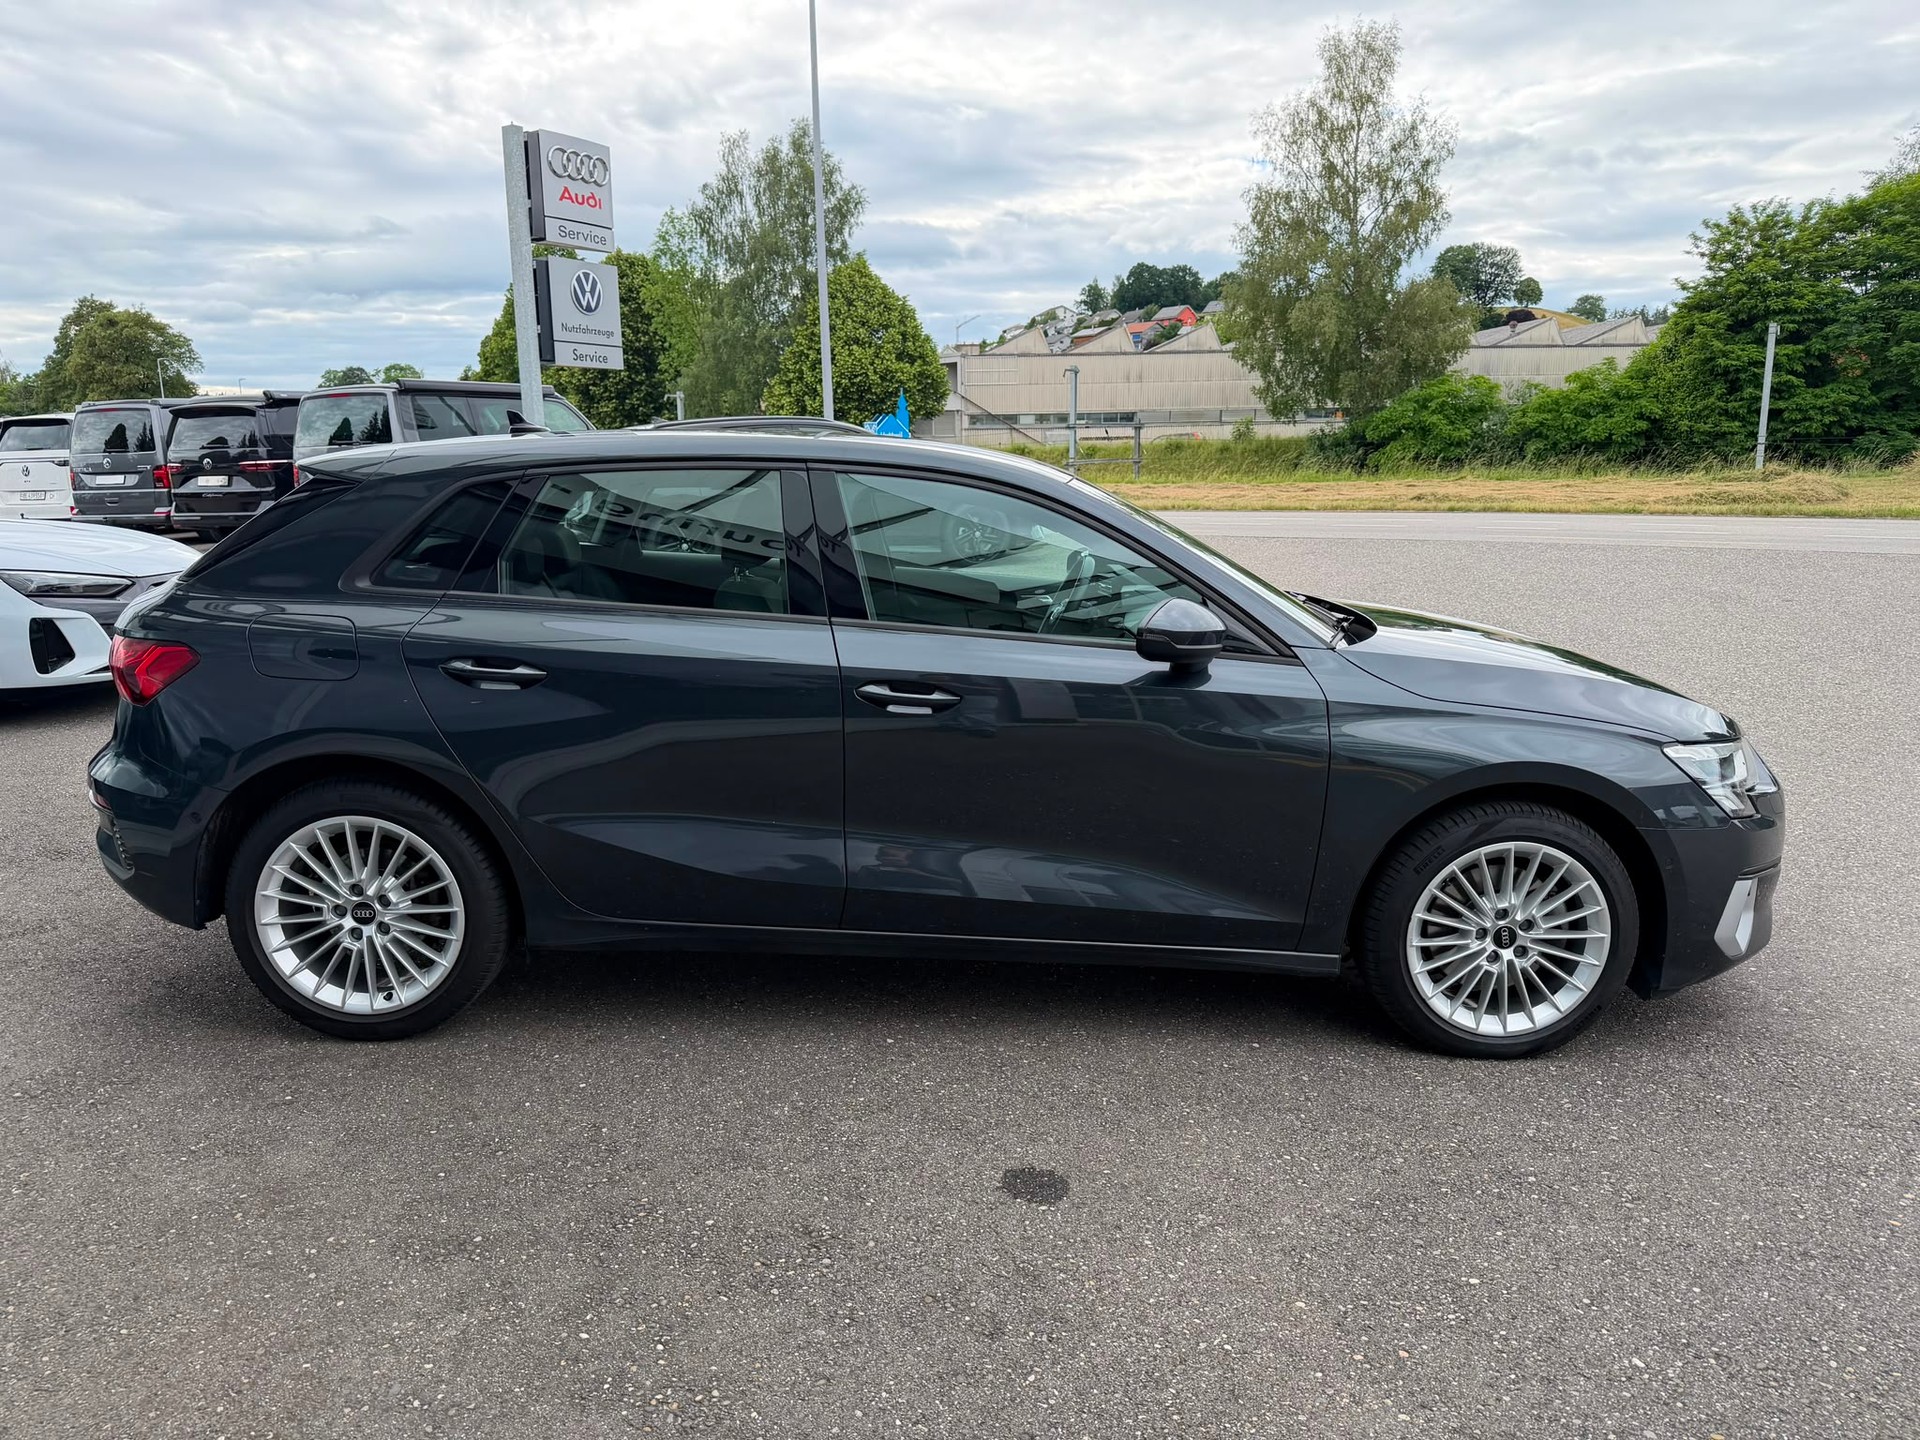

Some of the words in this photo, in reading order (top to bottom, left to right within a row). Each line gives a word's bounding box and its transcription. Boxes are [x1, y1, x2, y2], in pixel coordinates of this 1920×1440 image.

[558, 186, 603, 210] Audi
[558, 225, 607, 246] Service
[561, 322, 615, 339] Nutzfahrzeuge
[572, 348, 609, 364] Service
